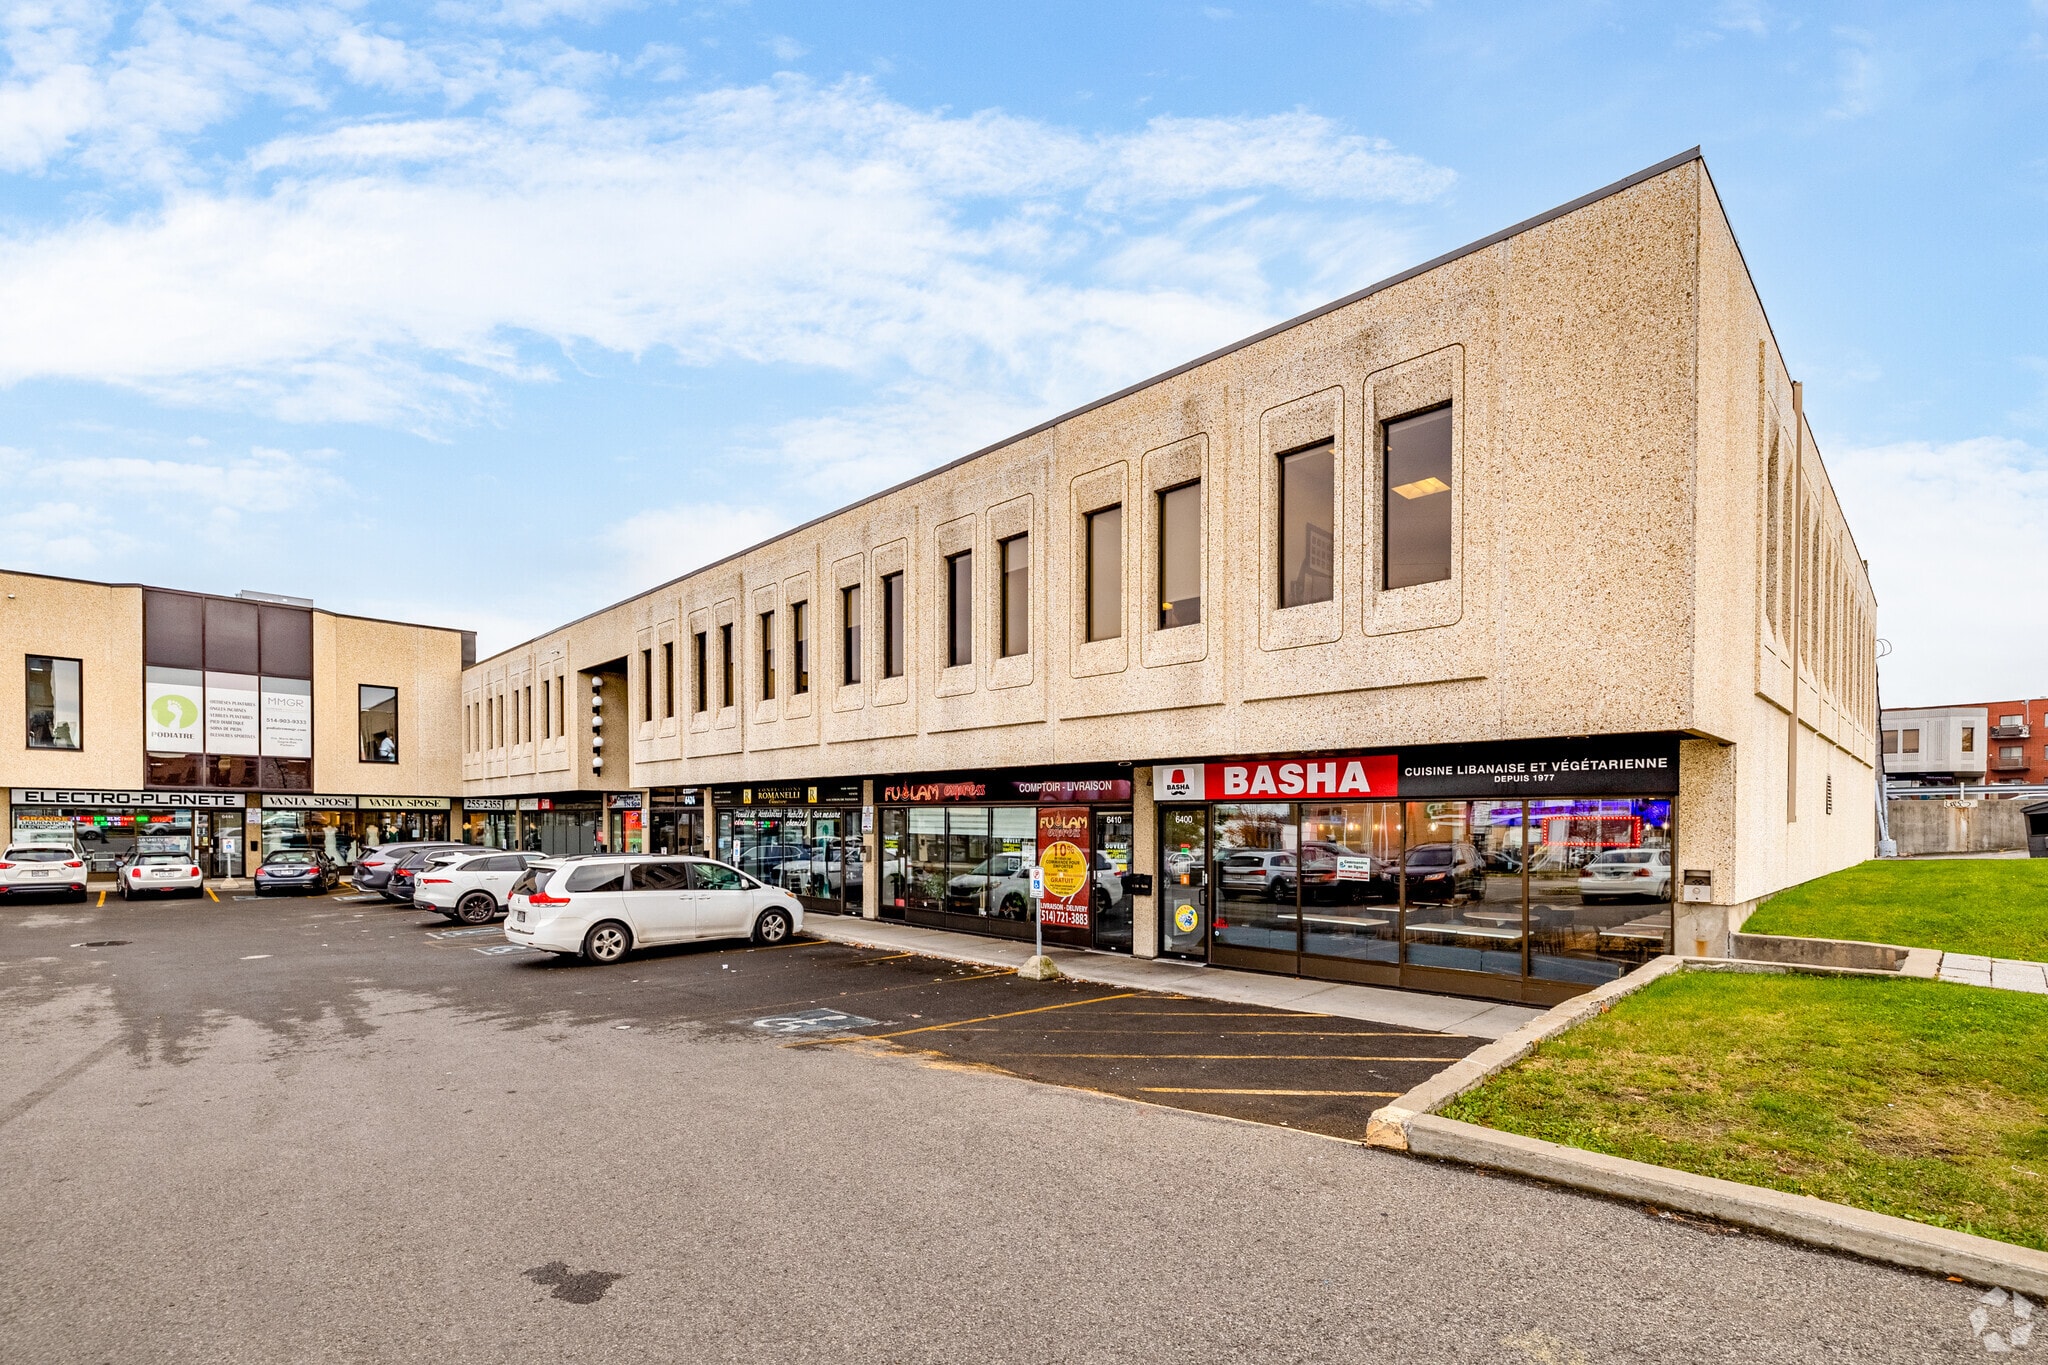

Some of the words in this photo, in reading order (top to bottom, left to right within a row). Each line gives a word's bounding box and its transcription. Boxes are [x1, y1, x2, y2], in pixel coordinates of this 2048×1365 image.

[267, 697, 304, 708] MMGR
[151, 731, 195, 740] PODIATRE
[1404, 765, 1453, 777] CUISINE
[1456, 763, 1525, 775] LIBANAISE
[1529, 762, 1546, 773] ET
[1551, 757, 1668, 772] VÉGÉTARIENNE
[1224, 761, 1371, 796] BASHA
[1494, 774, 1530, 783] DEPUIS
[1532, 773, 1555, 782] 1977
[1019, 782, 1061, 793] COMPTOIR
[1067, 780, 1112, 792] LIVRAISON
[757, 791, 801, 800] ROMANELLI
[884, 786, 901, 801] FU
[910, 785, 939, 801] LAM
[943, 784, 986, 801] express
[25, 791, 235, 805] ELECTRO-PLANETE
[270, 797, 308, 806] VANIA
[314, 797, 353, 807] SPOSE
[369, 798, 403, 807] VANIA
[406, 799, 441, 808] SPOSE
[467, 799, 502, 809] 255-2355
[1039, 817, 1054, 829] FU
[1063, 816, 1088, 829] LAM
[1106, 816, 1122, 824] 6410
[1175, 815, 1193, 824] 6400
[1053, 843, 1075, 857] 10%
[1066, 904, 1088, 912] DELIVERY
[1056, 911, 1088, 925] 721-3883
